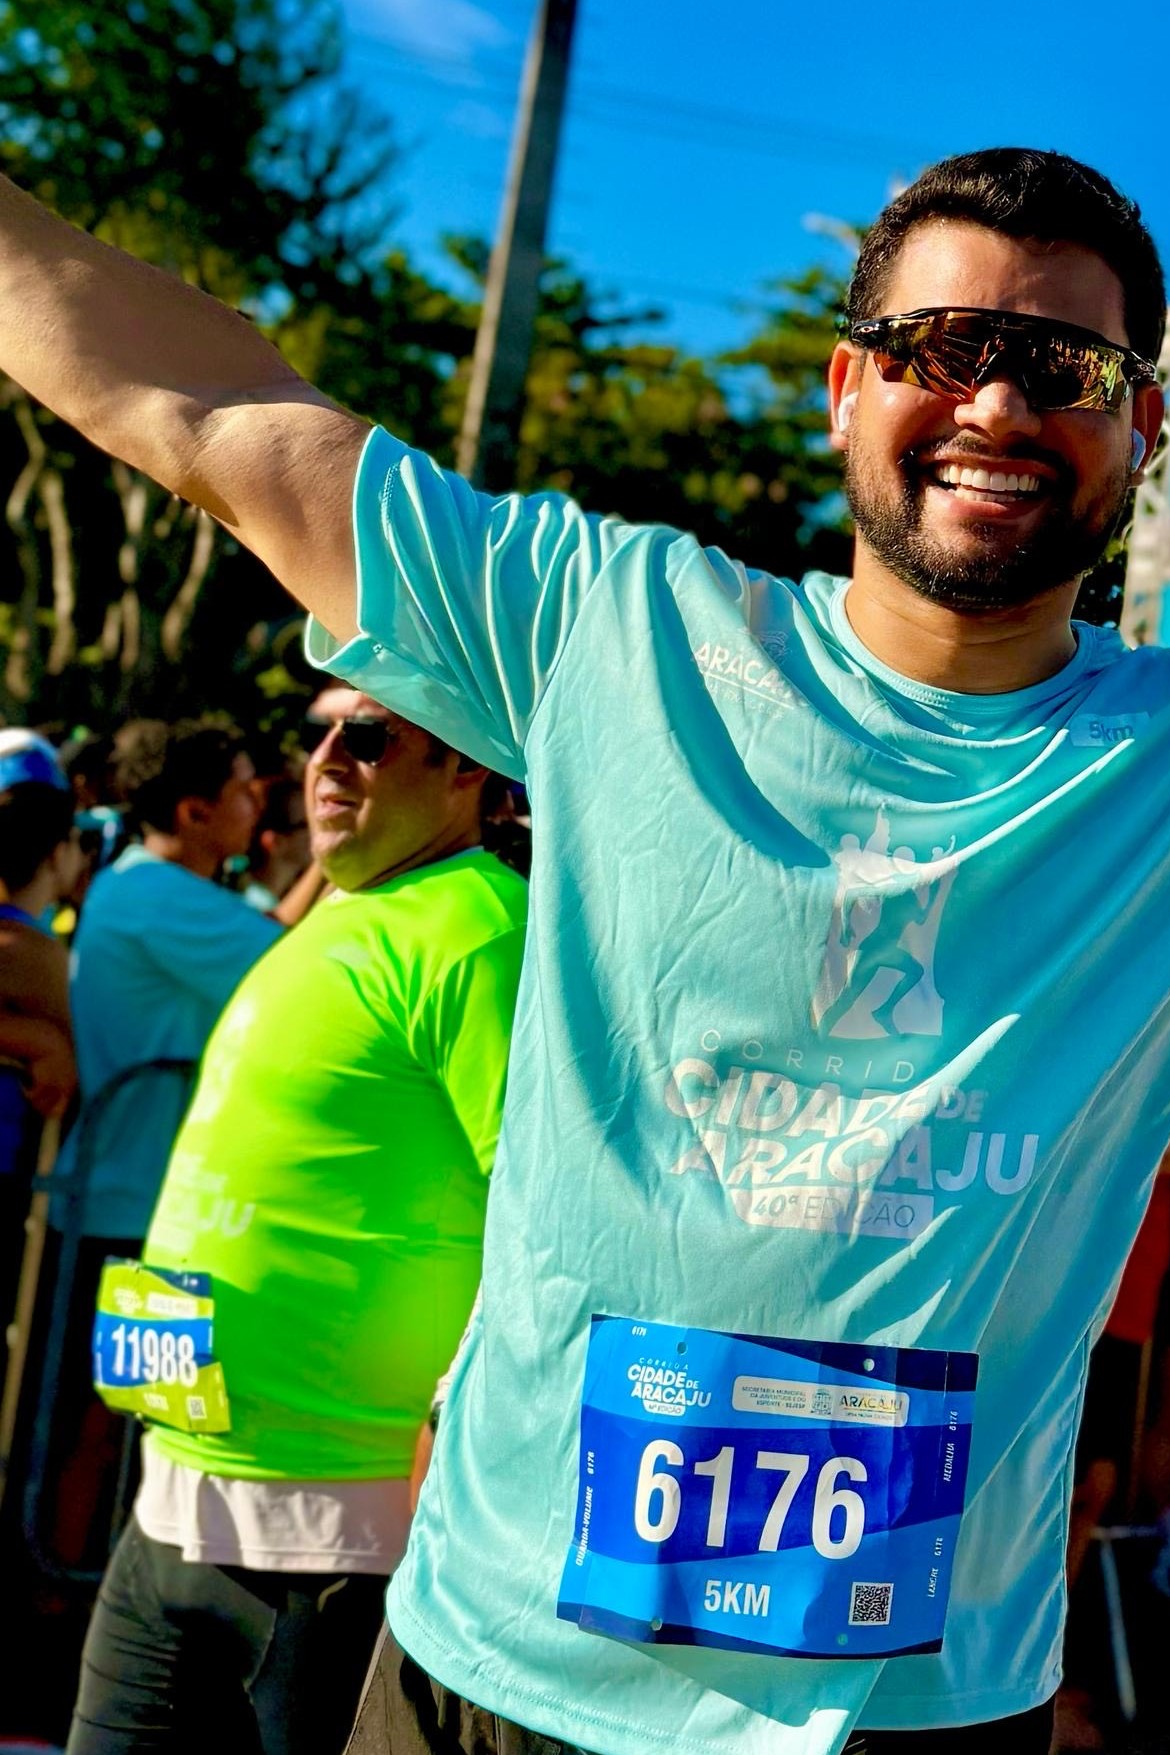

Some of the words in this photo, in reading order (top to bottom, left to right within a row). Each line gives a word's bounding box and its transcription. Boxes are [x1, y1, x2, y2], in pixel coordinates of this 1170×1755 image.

[700, 1028, 945, 1083] CORRID
[664, 1057, 930, 1138] CIDADE
[935, 1087, 989, 1122] DE
[669, 1125, 1040, 1195] ARACAJU
[111, 1323, 198, 1388] 11988
[627, 1364, 687, 1388] CIDADE
[686, 1379, 699, 1389] DE
[639, 1357, 689, 1370] CORRIDA
[631, 1381, 712, 1407] ARACAJU
[840, 1395, 902, 1411] ARACAJU
[634, 1439, 868, 1560] 6176
[704, 1579, 771, 1617] 5KM
